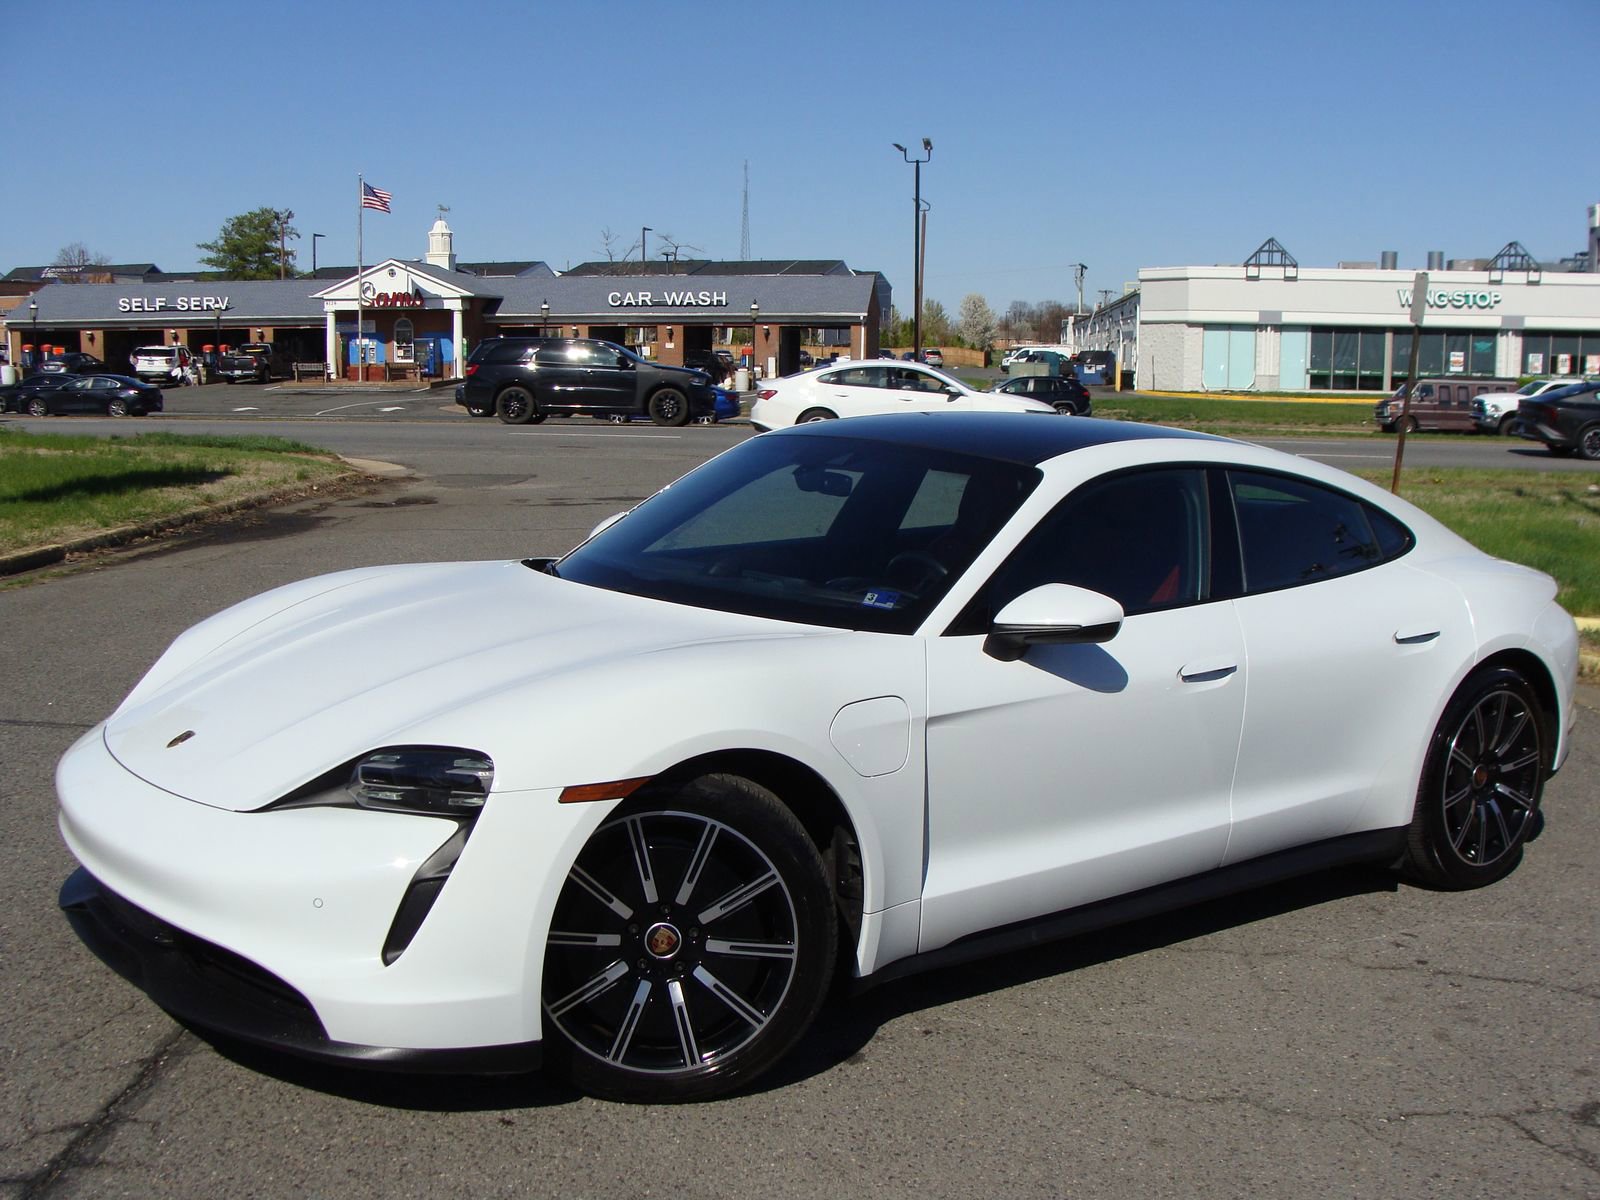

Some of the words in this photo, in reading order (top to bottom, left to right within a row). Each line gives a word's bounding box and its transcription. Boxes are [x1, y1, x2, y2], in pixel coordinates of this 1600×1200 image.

[119, 298, 166, 312] SELF
[177, 296, 229, 311] SERV
[608, 291, 652, 306] CAR
[664, 291, 727, 306] WASH
